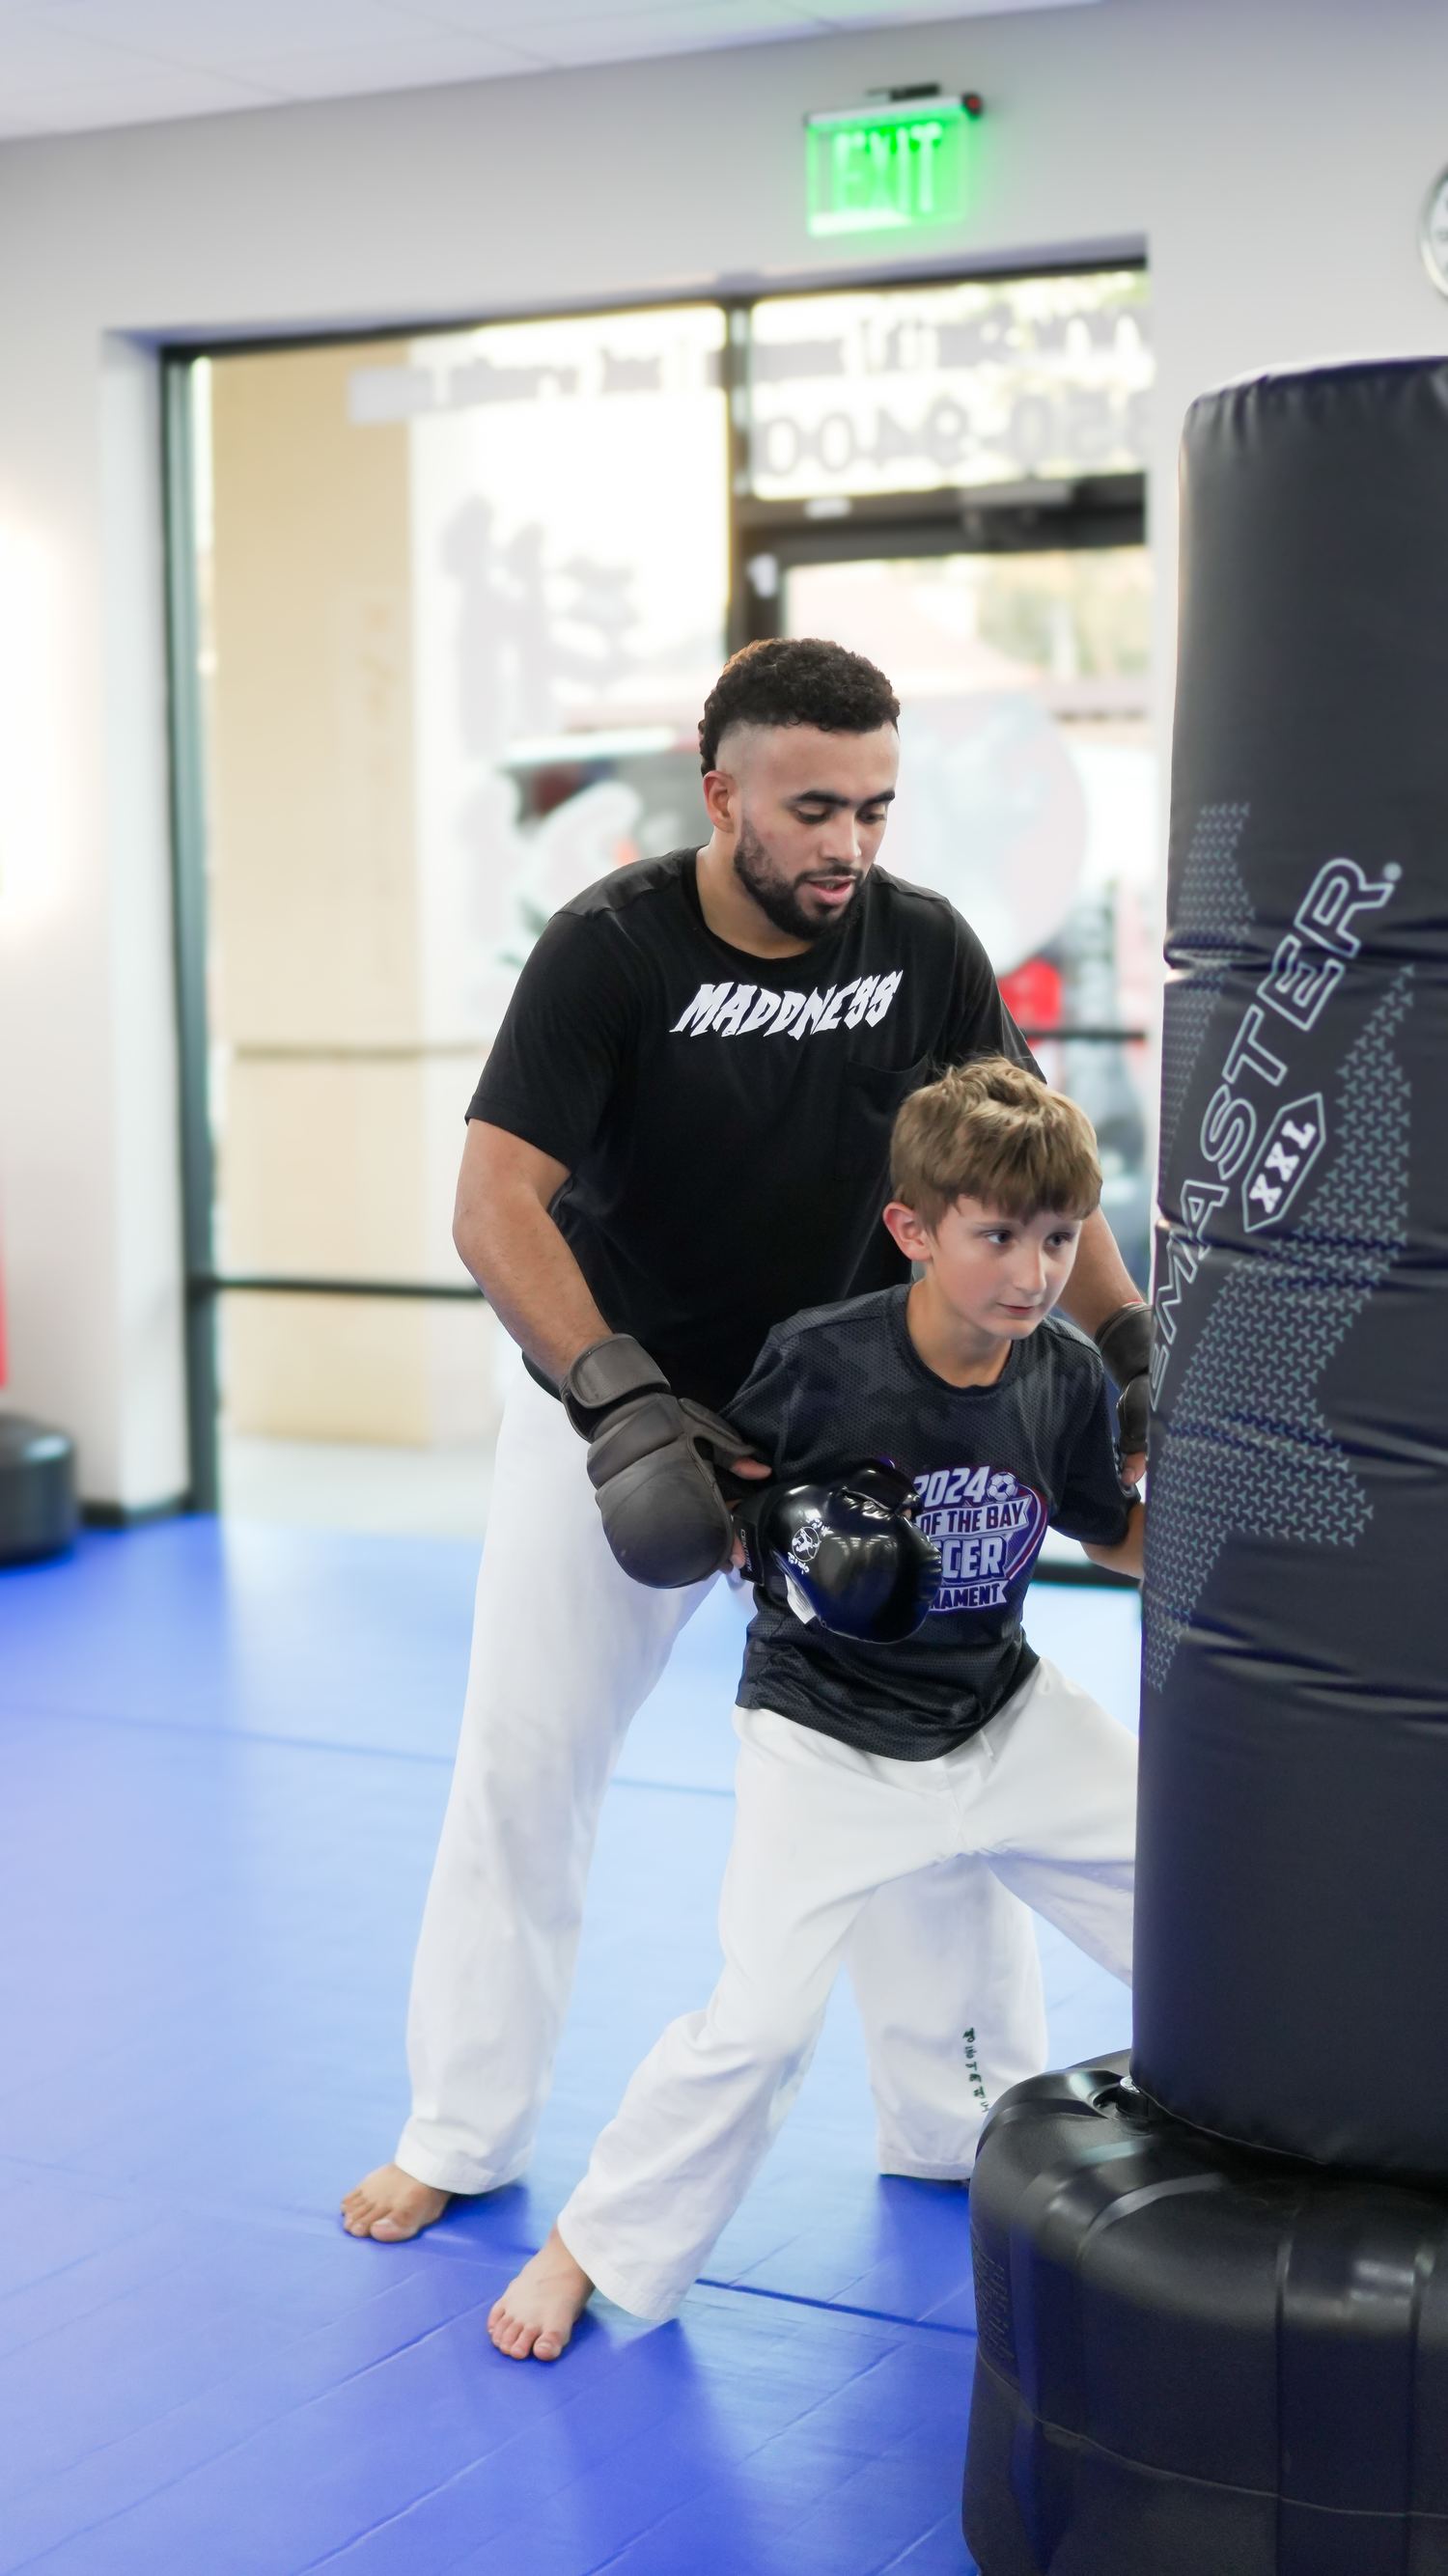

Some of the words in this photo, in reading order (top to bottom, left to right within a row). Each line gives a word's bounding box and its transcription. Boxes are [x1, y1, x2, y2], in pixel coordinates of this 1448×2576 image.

[832, 121, 943, 213] EXIT
[669, 970, 904, 1041] MADDNESS
[1249, 1120, 1317, 1214] XXL
[913, 1465, 990, 1508] 2024
[920, 1511, 943, 1536] OF
[947, 1510, 983, 1533] THE
[986, 1501, 1025, 1530] BAY
